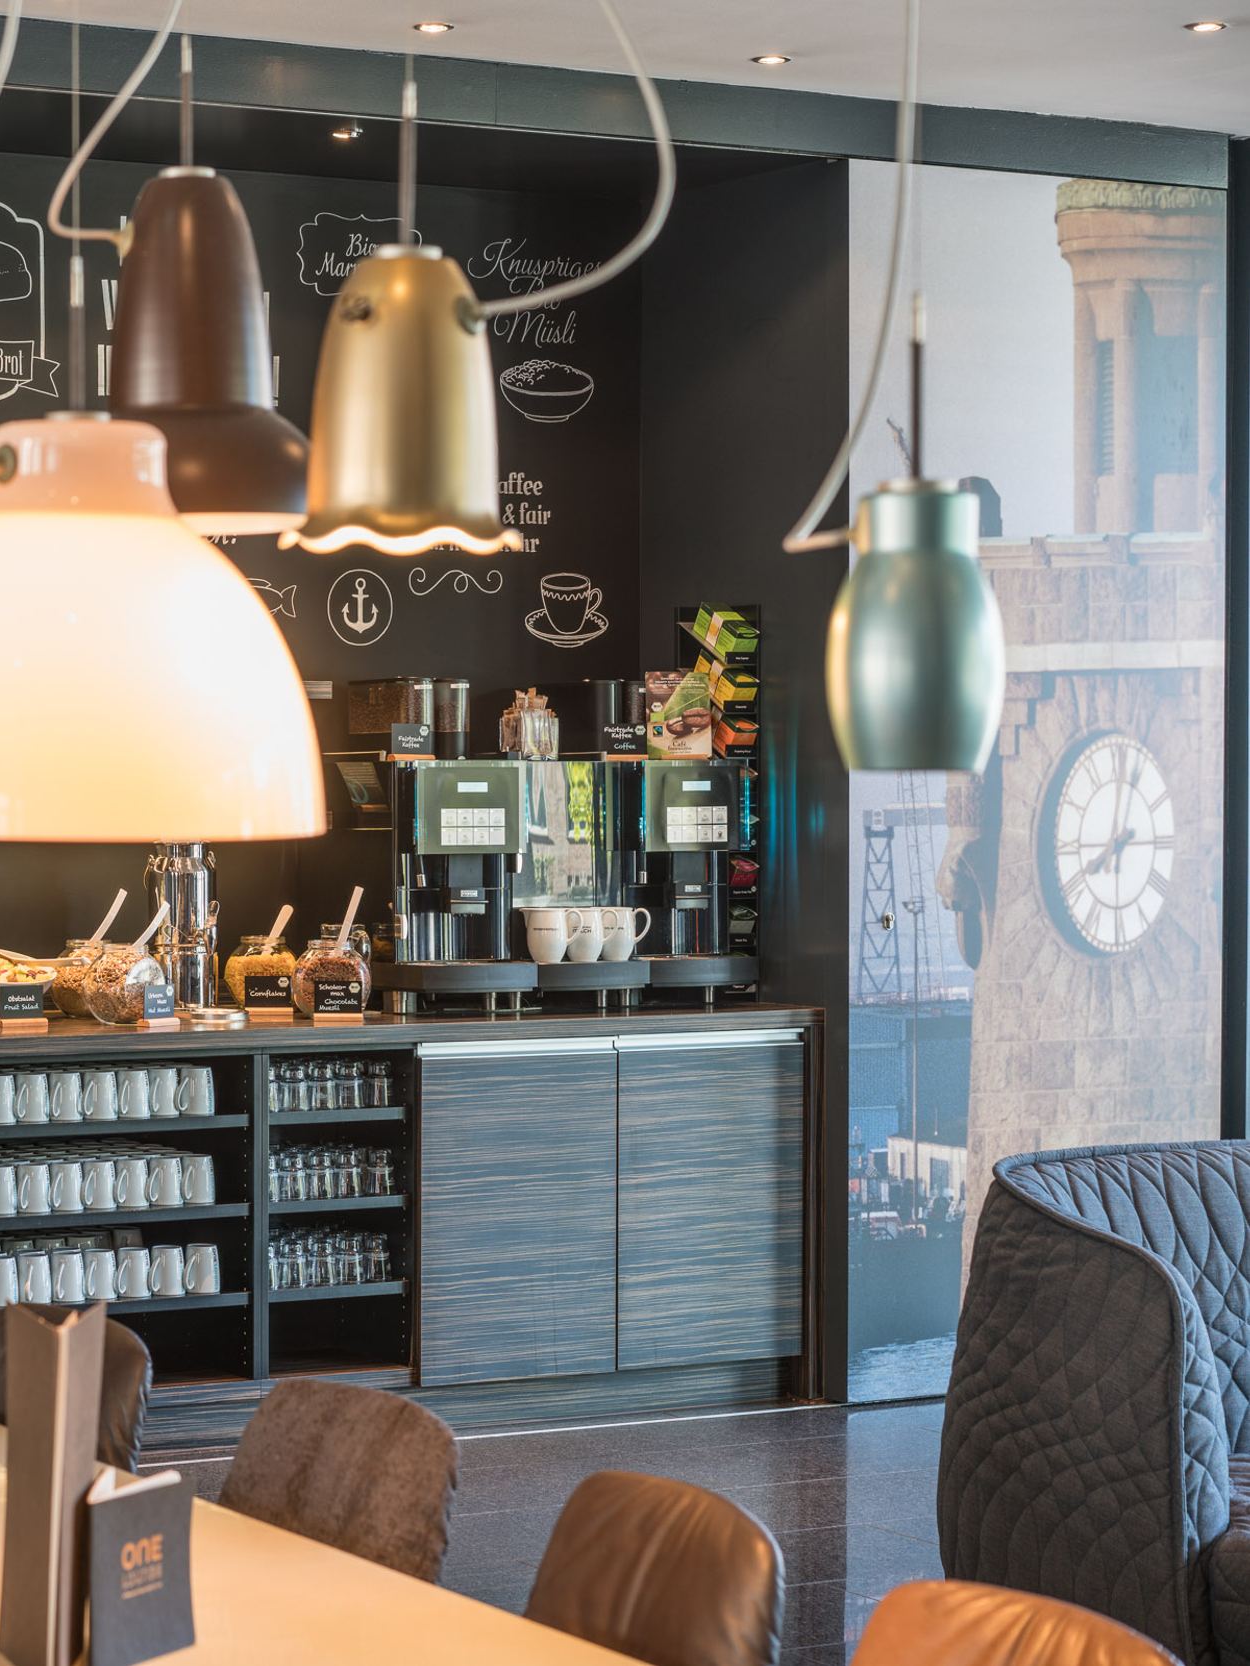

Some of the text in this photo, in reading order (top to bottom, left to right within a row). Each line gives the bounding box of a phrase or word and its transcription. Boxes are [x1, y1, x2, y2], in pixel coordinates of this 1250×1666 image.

[315, 251, 357, 277] Mar
[493, 309, 577, 349] Müsli
[502, 501, 551, 525] & fair
[613, 742, 636, 750] Coffee
[249, 988, 286, 998] Cornflakes
